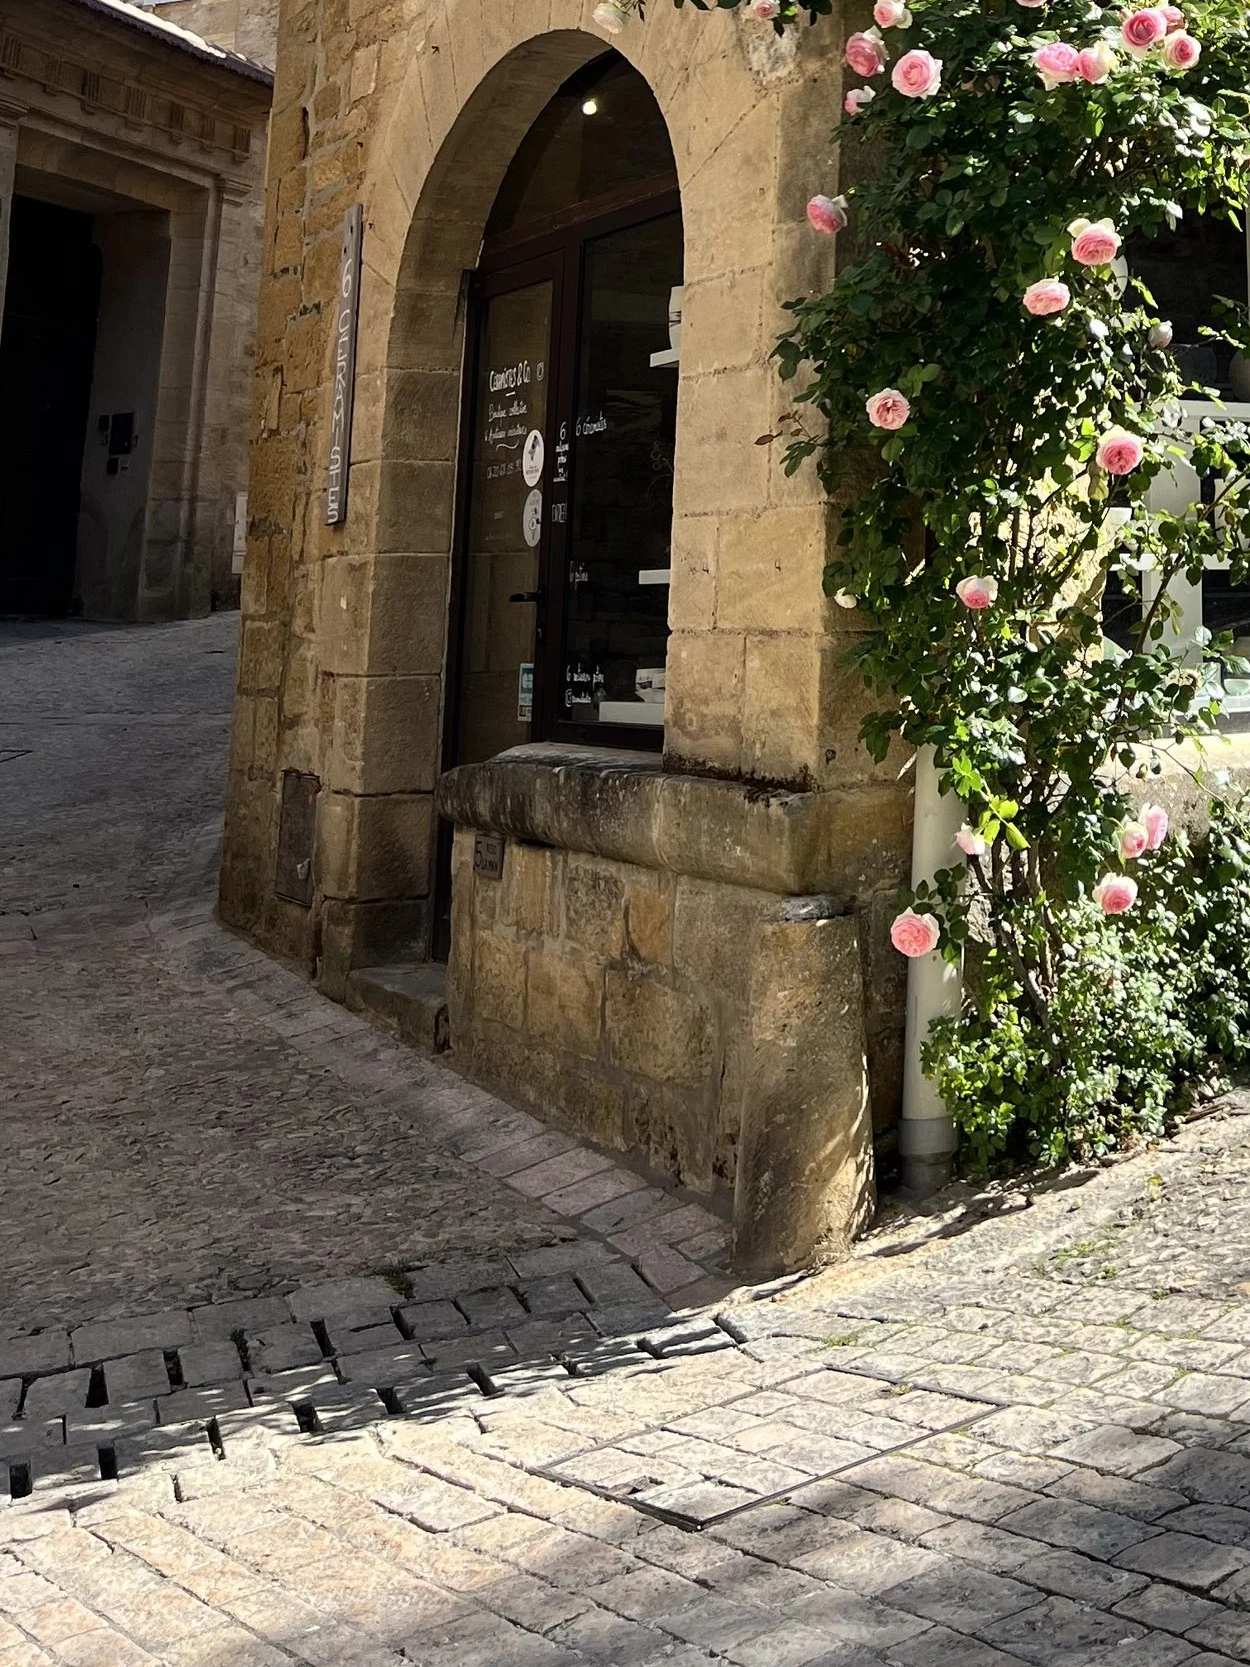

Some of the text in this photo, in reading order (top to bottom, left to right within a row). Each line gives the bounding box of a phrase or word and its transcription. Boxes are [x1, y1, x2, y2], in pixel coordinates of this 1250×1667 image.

[341, 257, 353, 299] 6
[560, 421, 567, 440] 6
[575, 416, 582, 437] 6
